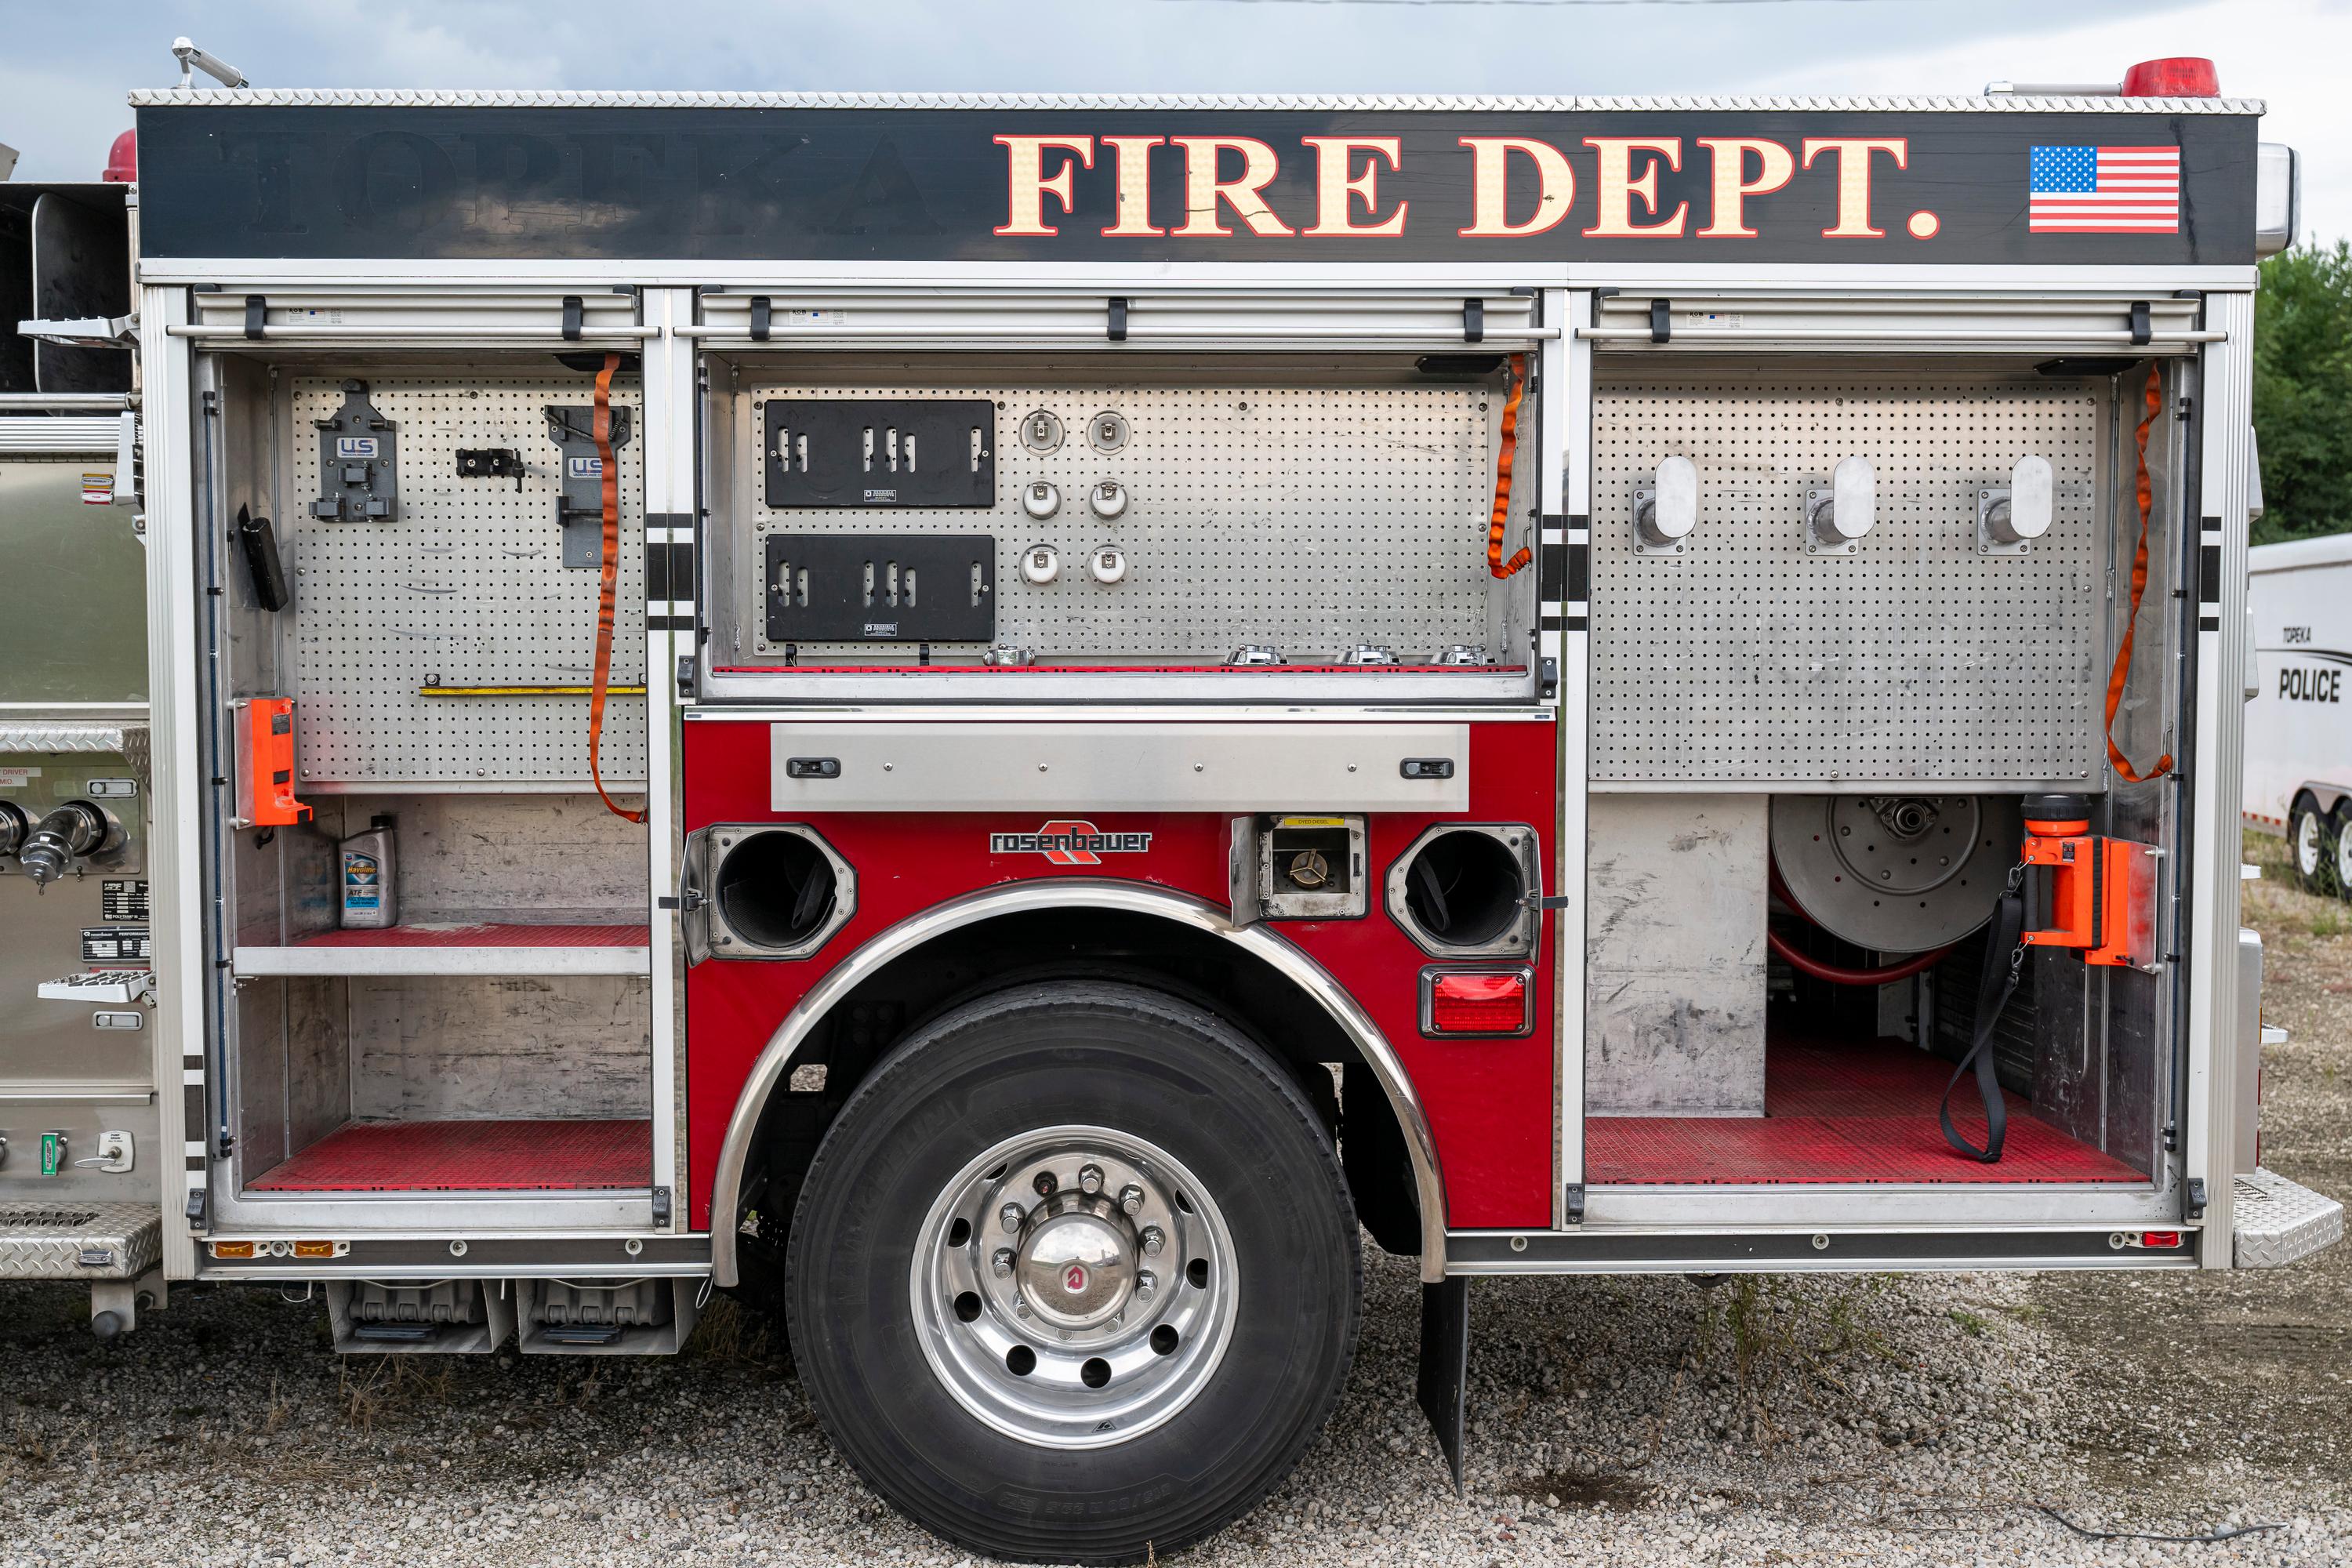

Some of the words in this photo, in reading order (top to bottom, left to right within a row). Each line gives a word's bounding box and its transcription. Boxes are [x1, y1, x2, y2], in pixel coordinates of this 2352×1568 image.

[993, 134, 1409, 238] FIRE
[1457, 136, 1940, 241] DEPT.
[341, 439, 374, 453] US
[2283, 626, 2311, 643] TOPEKA
[2279, 668, 2341, 702] POLICE
[991, 826, 1152, 853] rosenbauer
